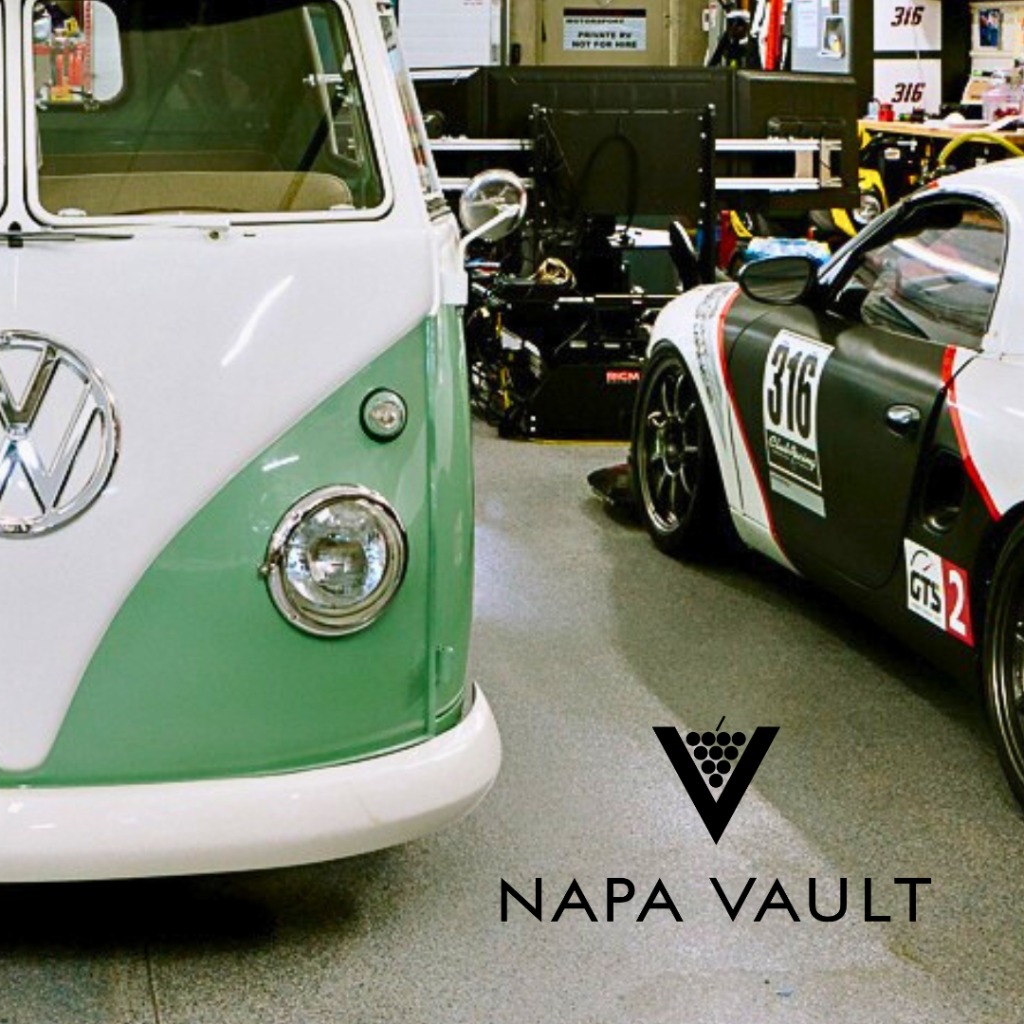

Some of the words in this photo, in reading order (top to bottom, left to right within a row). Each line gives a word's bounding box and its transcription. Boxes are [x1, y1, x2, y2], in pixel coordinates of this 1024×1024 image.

[890, 6, 925, 27] 316
[571, 41, 591, 49] NOT
[593, 41, 613, 49] FOR
[891, 82, 926, 103] 316
[767, 344, 818, 439] 316
[911, 570, 942, 614] GTS
[948, 569, 967, 637] 2
